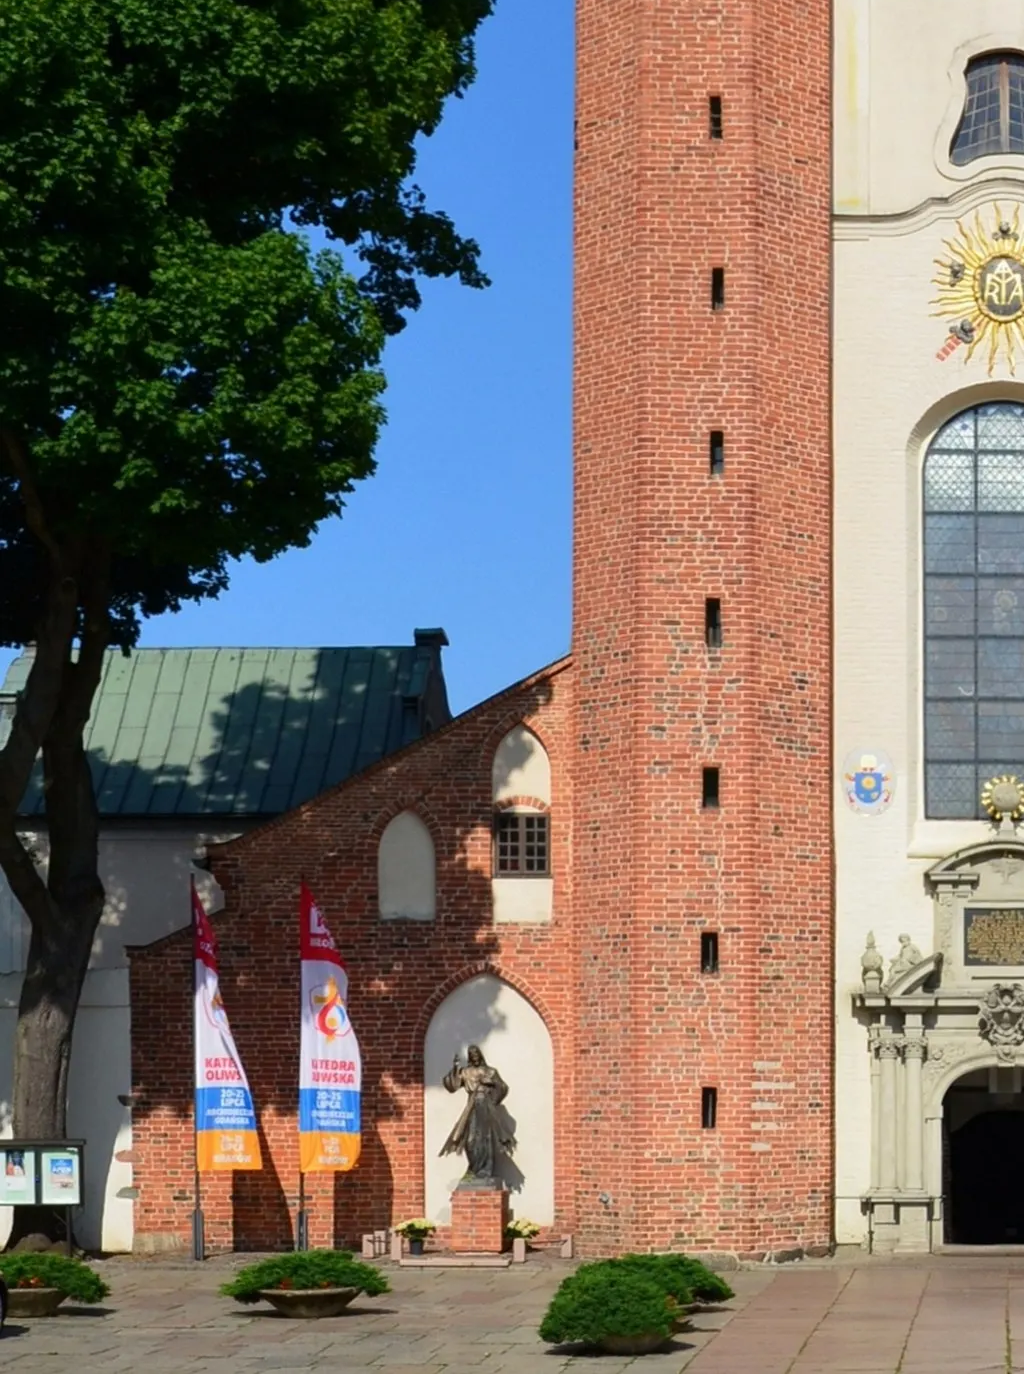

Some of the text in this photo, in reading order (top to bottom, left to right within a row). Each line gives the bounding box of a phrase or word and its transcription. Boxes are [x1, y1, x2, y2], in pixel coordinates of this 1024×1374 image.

[205, 1057, 237, 1068] KATE
[311, 1058, 355, 1071] TEDRA
[205, 1069, 242, 1081] OLIWS
